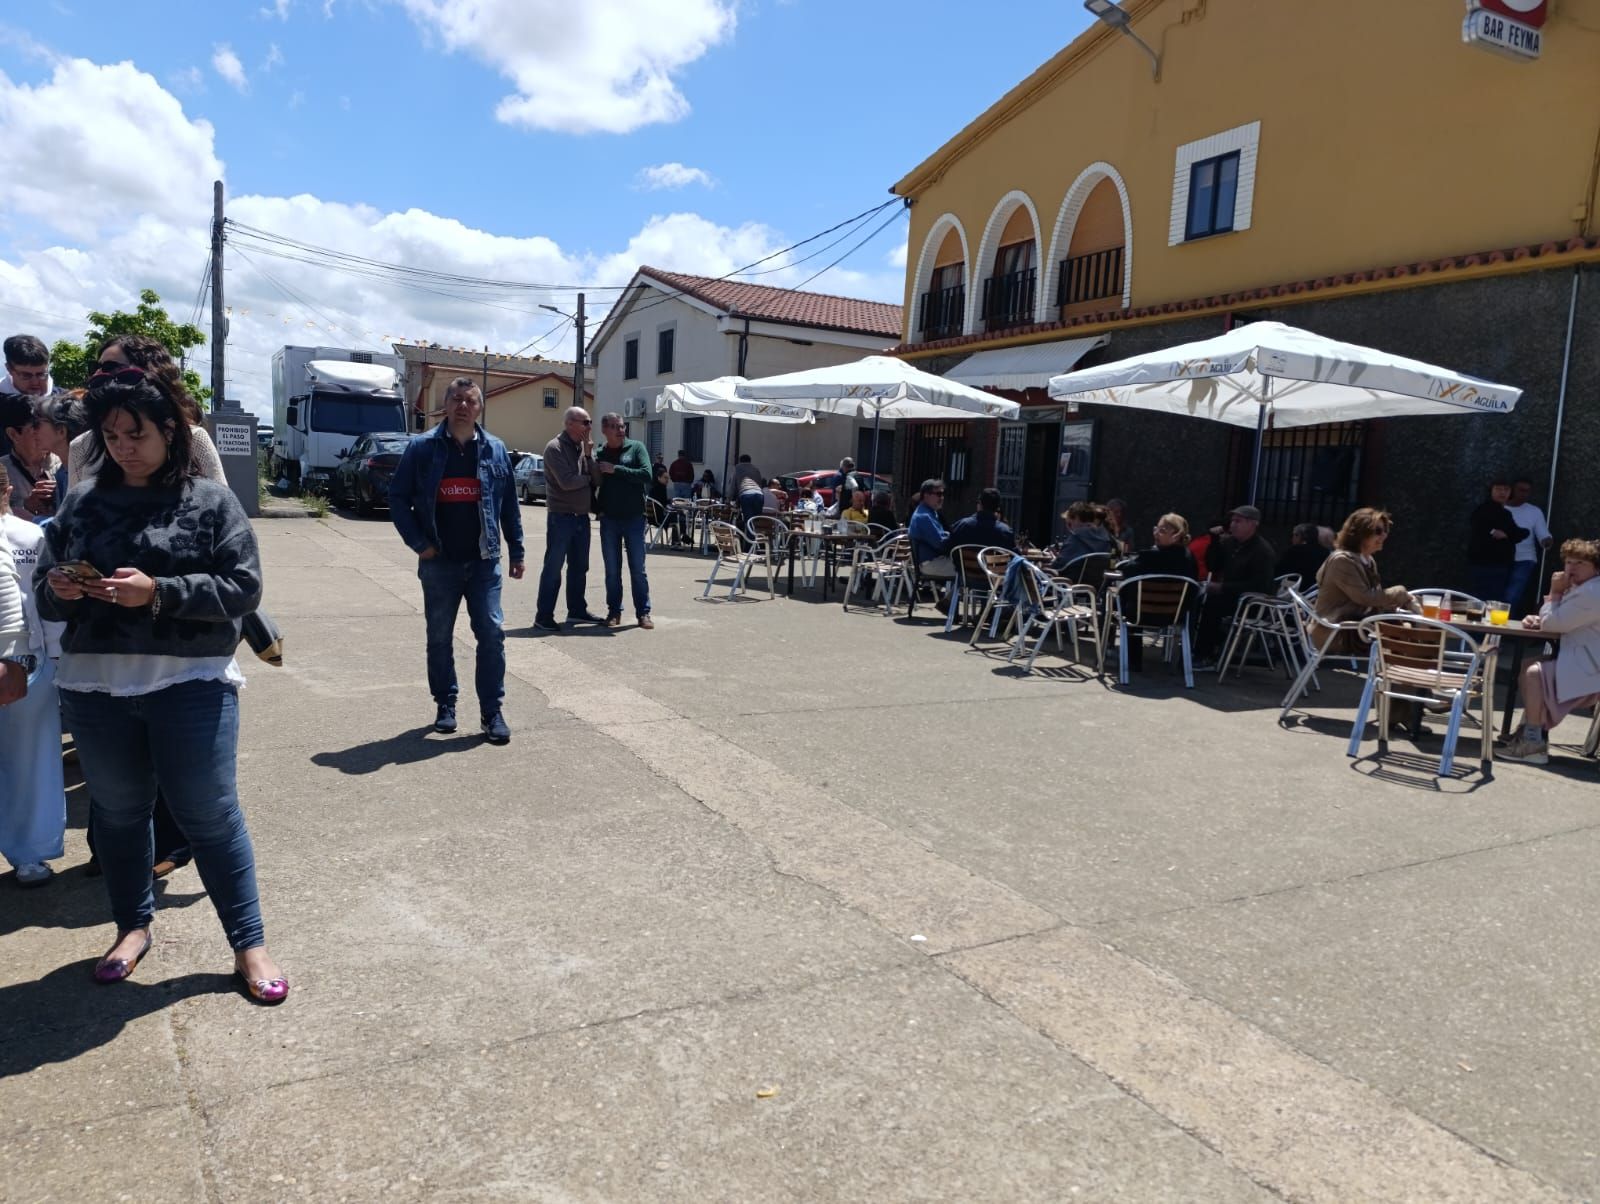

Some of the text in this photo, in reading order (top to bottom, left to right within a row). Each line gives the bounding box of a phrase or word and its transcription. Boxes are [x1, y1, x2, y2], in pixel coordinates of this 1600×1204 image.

[1483, 15, 1540, 53] BAR FEYMA
[1474, 396, 1507, 409] AGUILA
